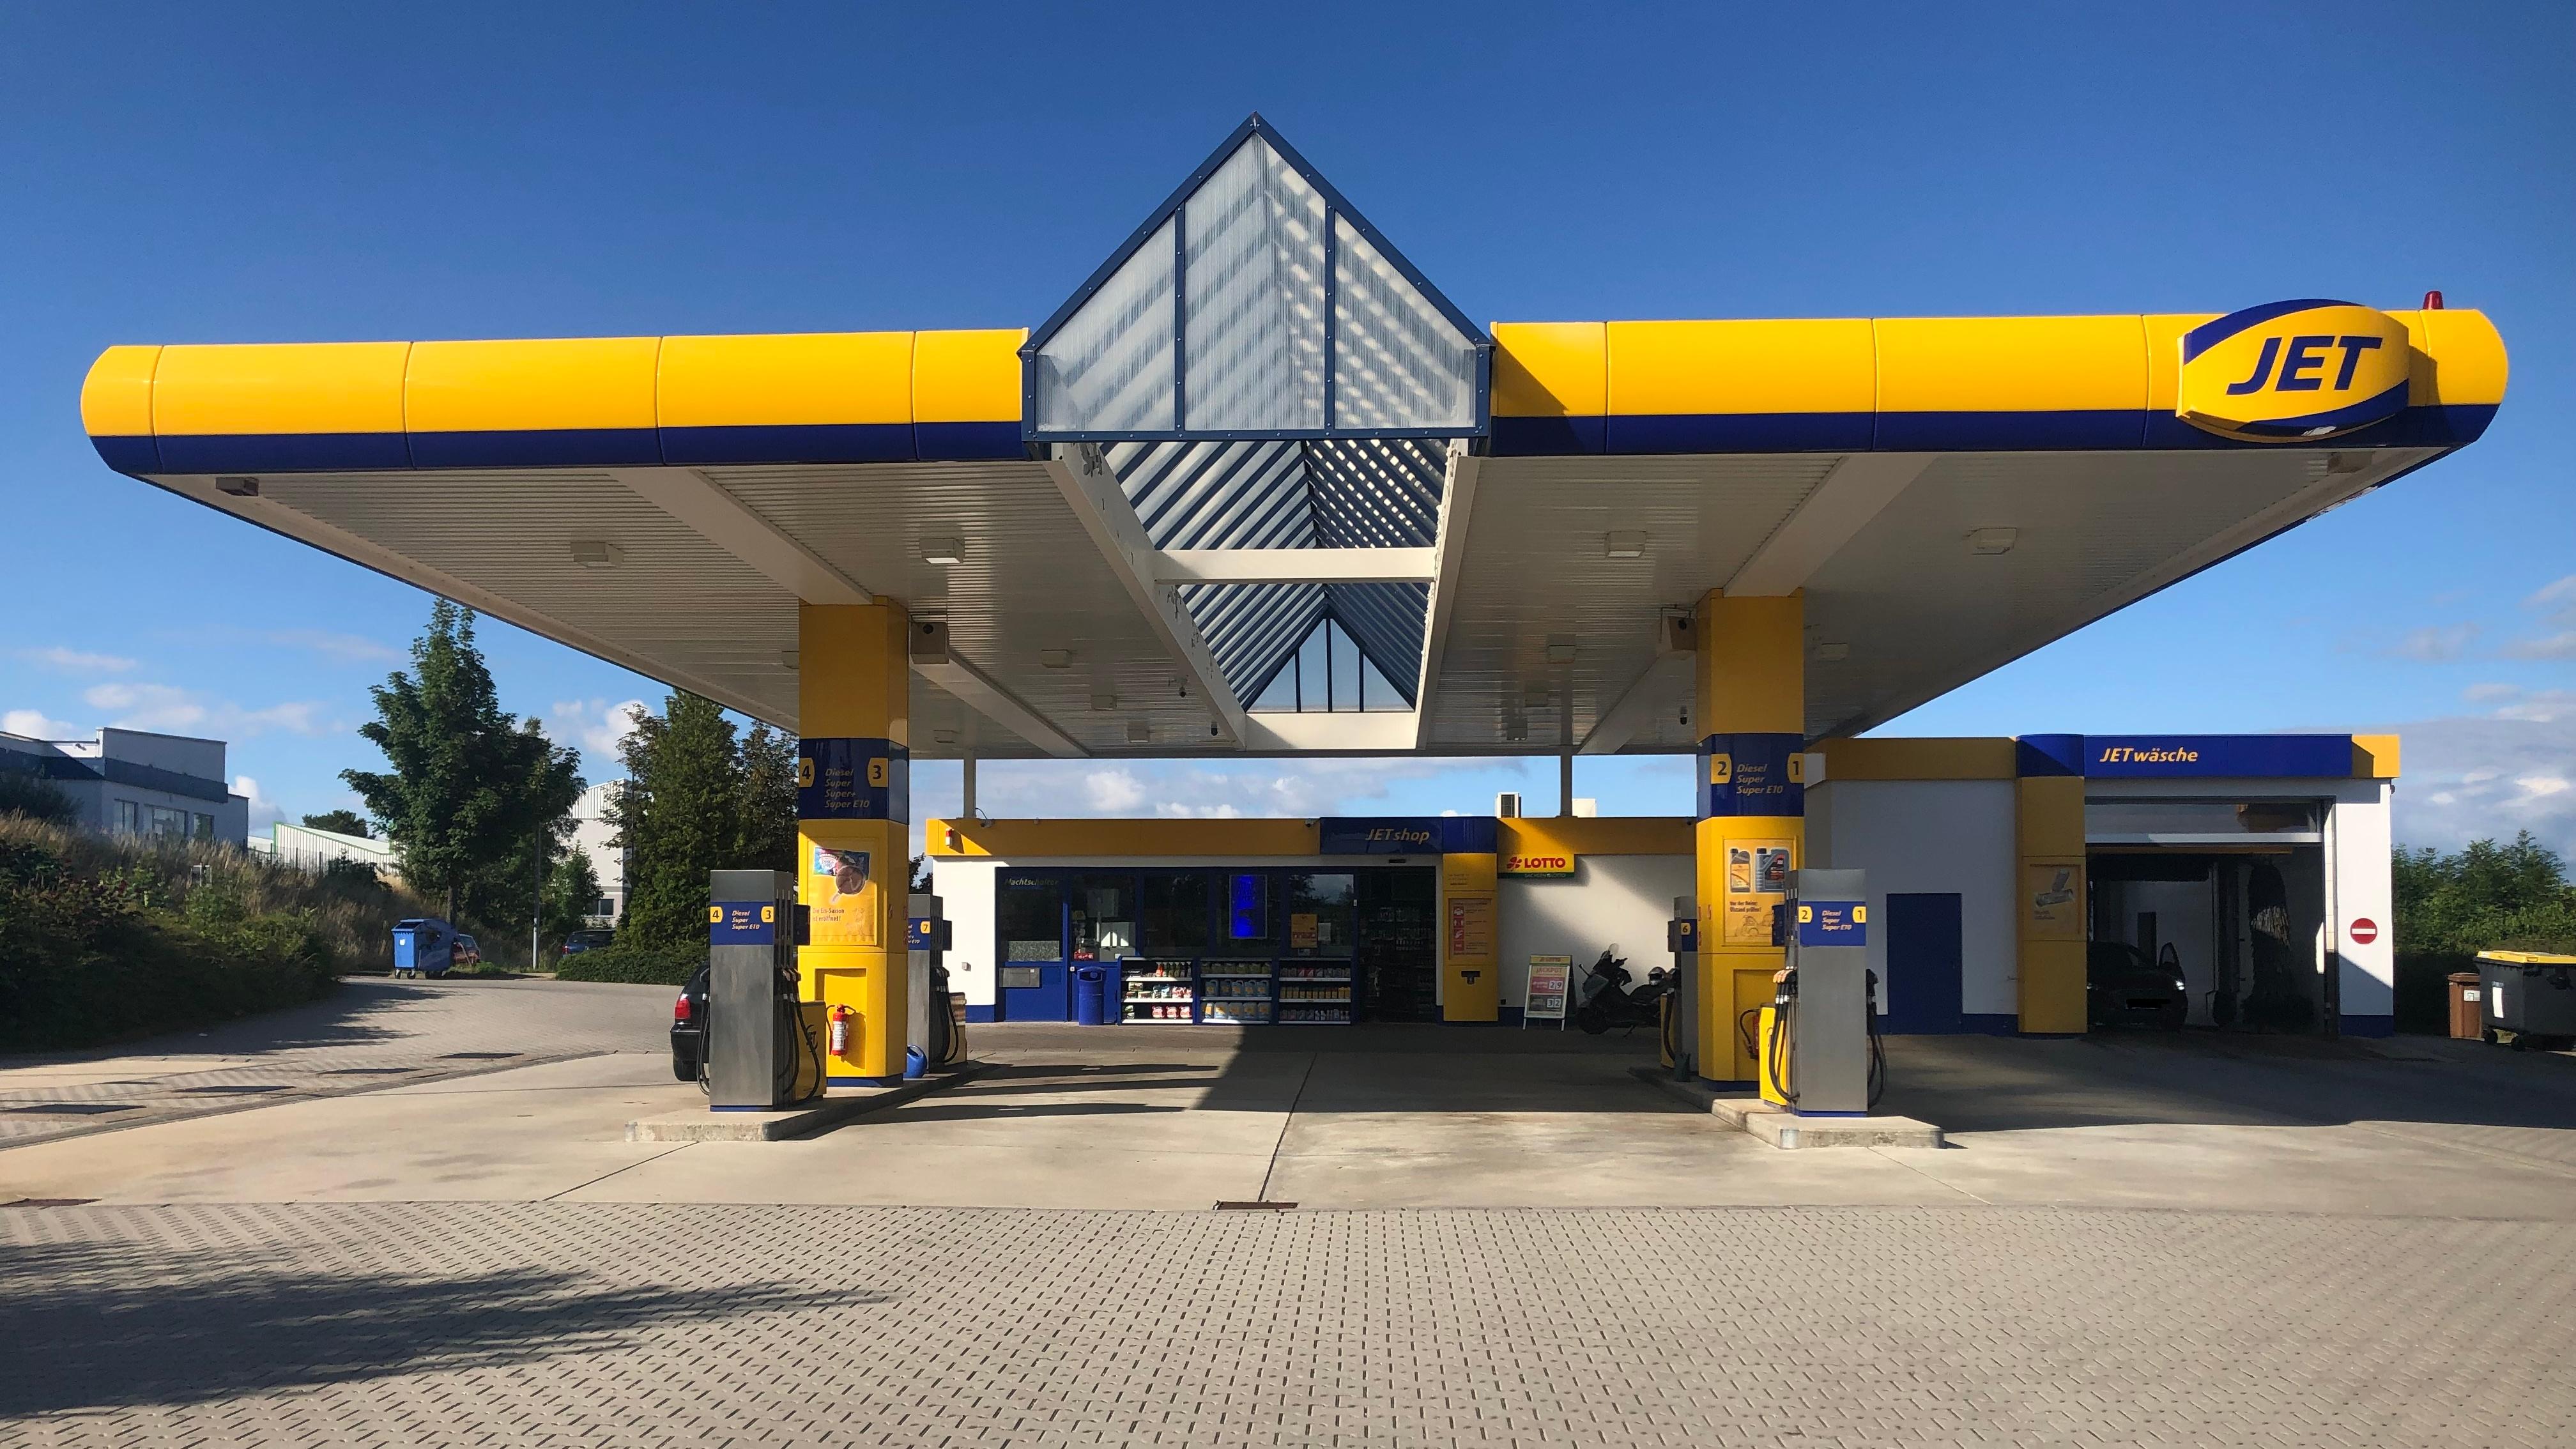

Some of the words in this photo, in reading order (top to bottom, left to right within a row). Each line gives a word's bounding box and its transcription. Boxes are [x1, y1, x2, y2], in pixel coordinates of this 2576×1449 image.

[2226, 335, 2383, 395] JET
[801, 765, 811, 779] 4
[825, 767, 854, 776] Diesel
[872, 765, 882, 779] 3
[1717, 761, 1727, 776] 2
[1736, 763, 1768, 772] Diesel
[1792, 760, 1799, 775] 1
[825, 779, 852, 788] Super
[1736, 775, 1765, 785] Super
[825, 789, 856, 799] Super+
[1736, 785, 1765, 796] Super
[1766, 785, 1783, 793] E10
[825, 800, 852, 810] Super
[853, 800, 870, 808] E10
[1524, 857, 1565, 868] LOTTO
[712, 910, 719, 919] 4
[765, 910, 772, 919] 3
[1802, 910, 1808, 919] 2
[1857, 910, 1862, 920] 1
